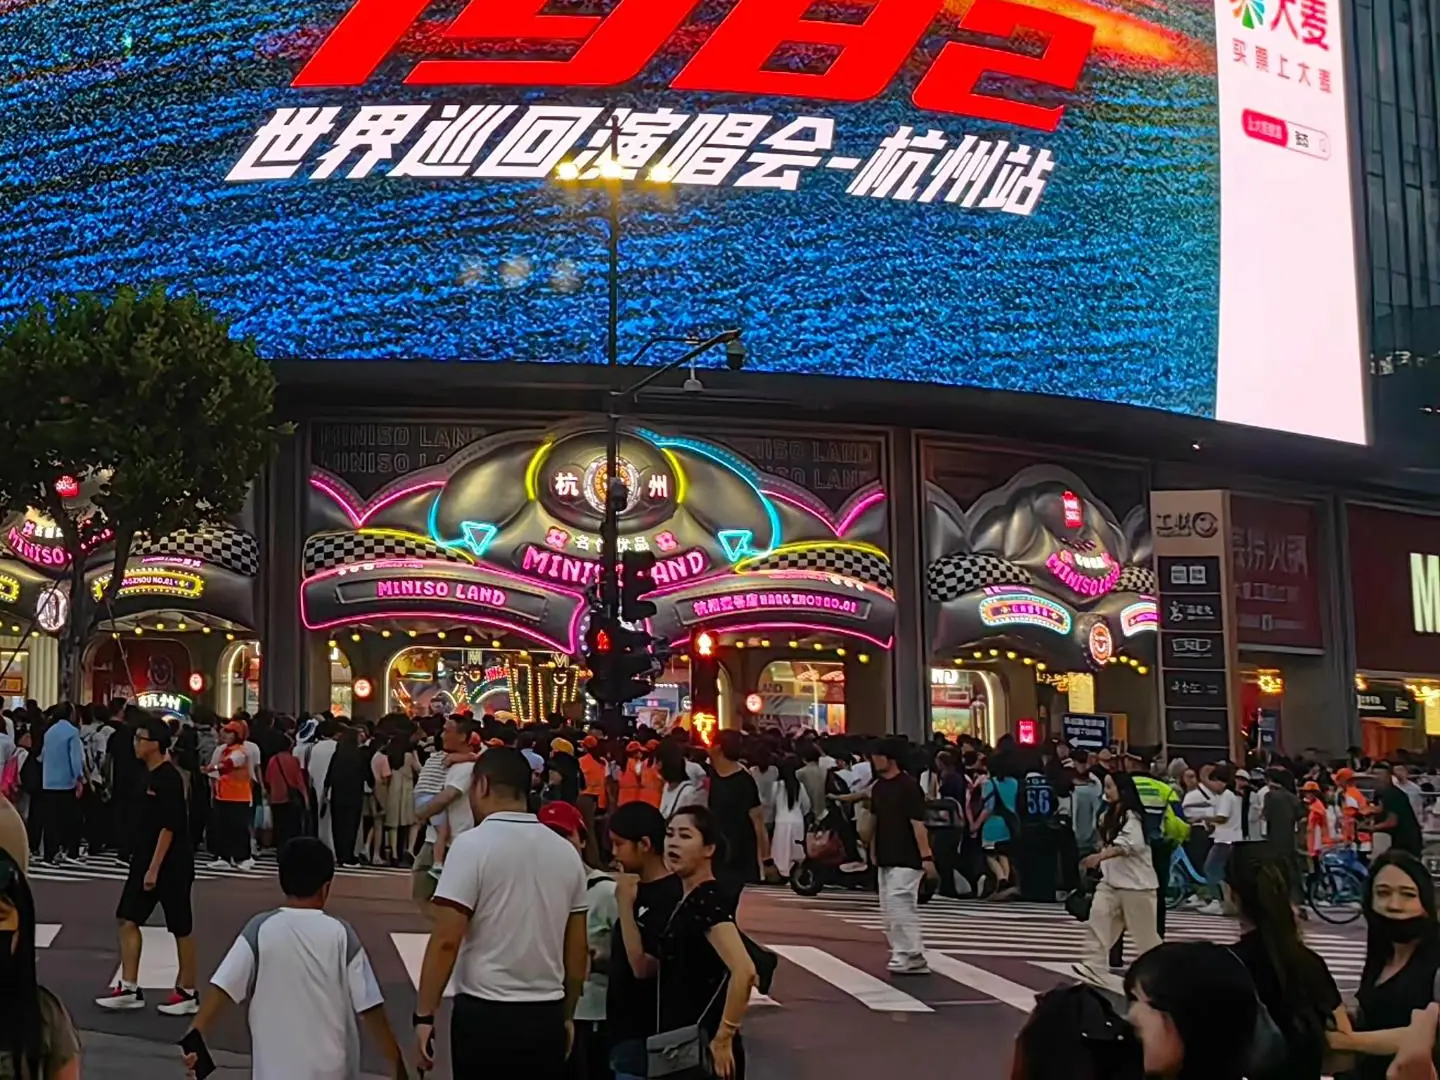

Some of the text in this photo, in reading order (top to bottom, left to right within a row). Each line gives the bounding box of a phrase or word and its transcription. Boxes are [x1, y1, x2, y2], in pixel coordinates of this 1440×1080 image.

[376, 580, 506, 606] MINISO LAND
[1026, 789, 1050, 814] 56
